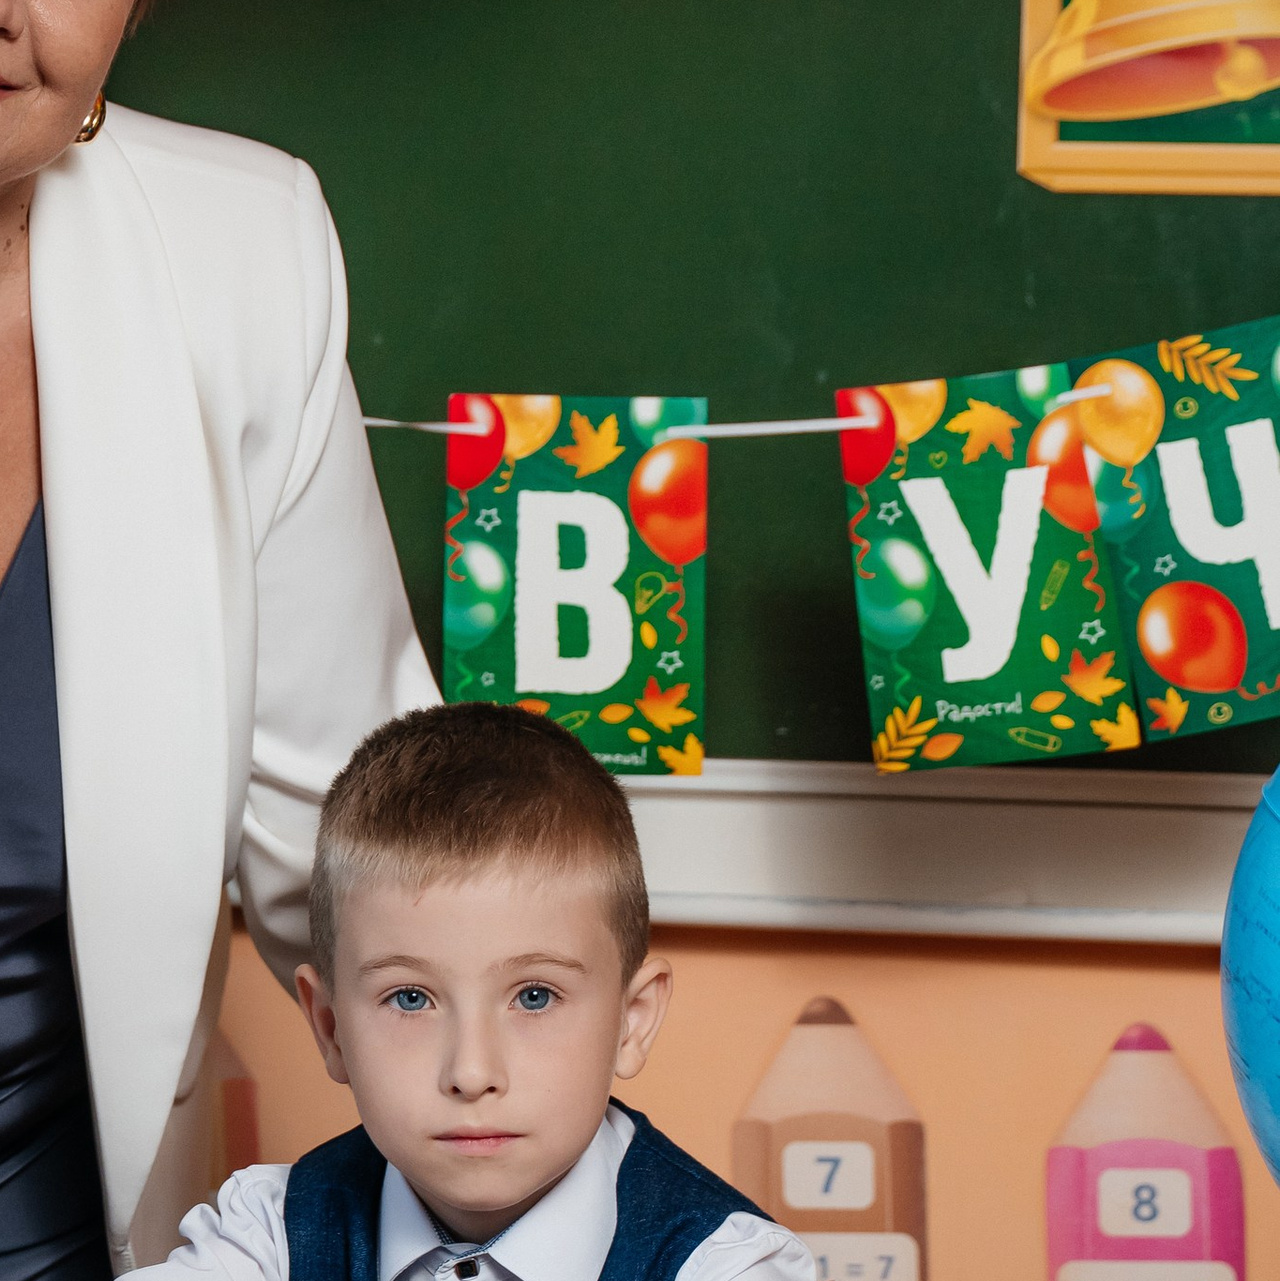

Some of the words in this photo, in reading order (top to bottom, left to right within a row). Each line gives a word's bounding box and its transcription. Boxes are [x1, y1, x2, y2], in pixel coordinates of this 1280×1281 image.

[515, 489, 632, 695] В
[935, 691, 1022, 722] Радости!
[815, 1156, 842, 1193] 7
[1133, 1184, 1160, 1222] 8
[877, 1255, 895, 1279] 7
